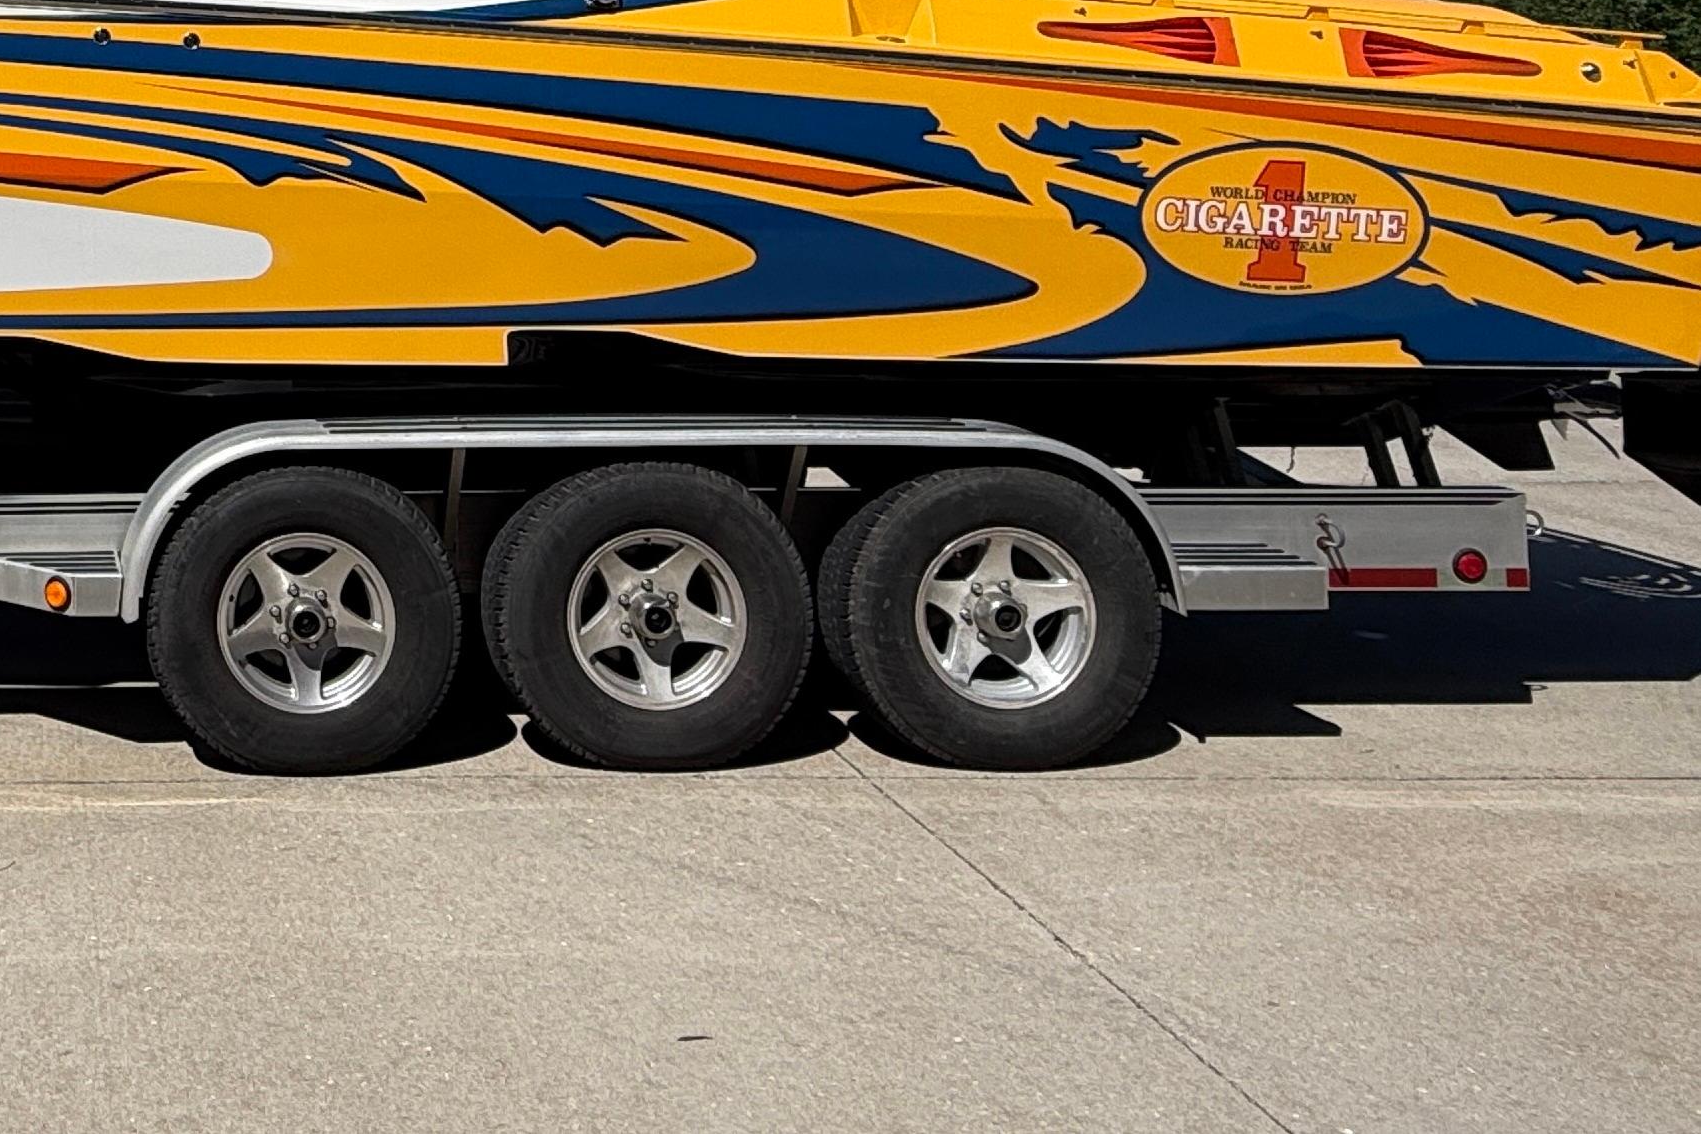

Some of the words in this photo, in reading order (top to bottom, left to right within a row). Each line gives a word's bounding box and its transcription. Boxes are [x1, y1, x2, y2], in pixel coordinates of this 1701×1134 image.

[1209, 185, 1266, 203] WORLD
[1273, 188, 1357, 205] CHAMPION
[1155, 195, 1410, 244] CIGARETTE
[1247, 159, 1307, 283] 1
[1223, 236, 1281, 252] RACING
[1290, 239, 1333, 254] TEAM
